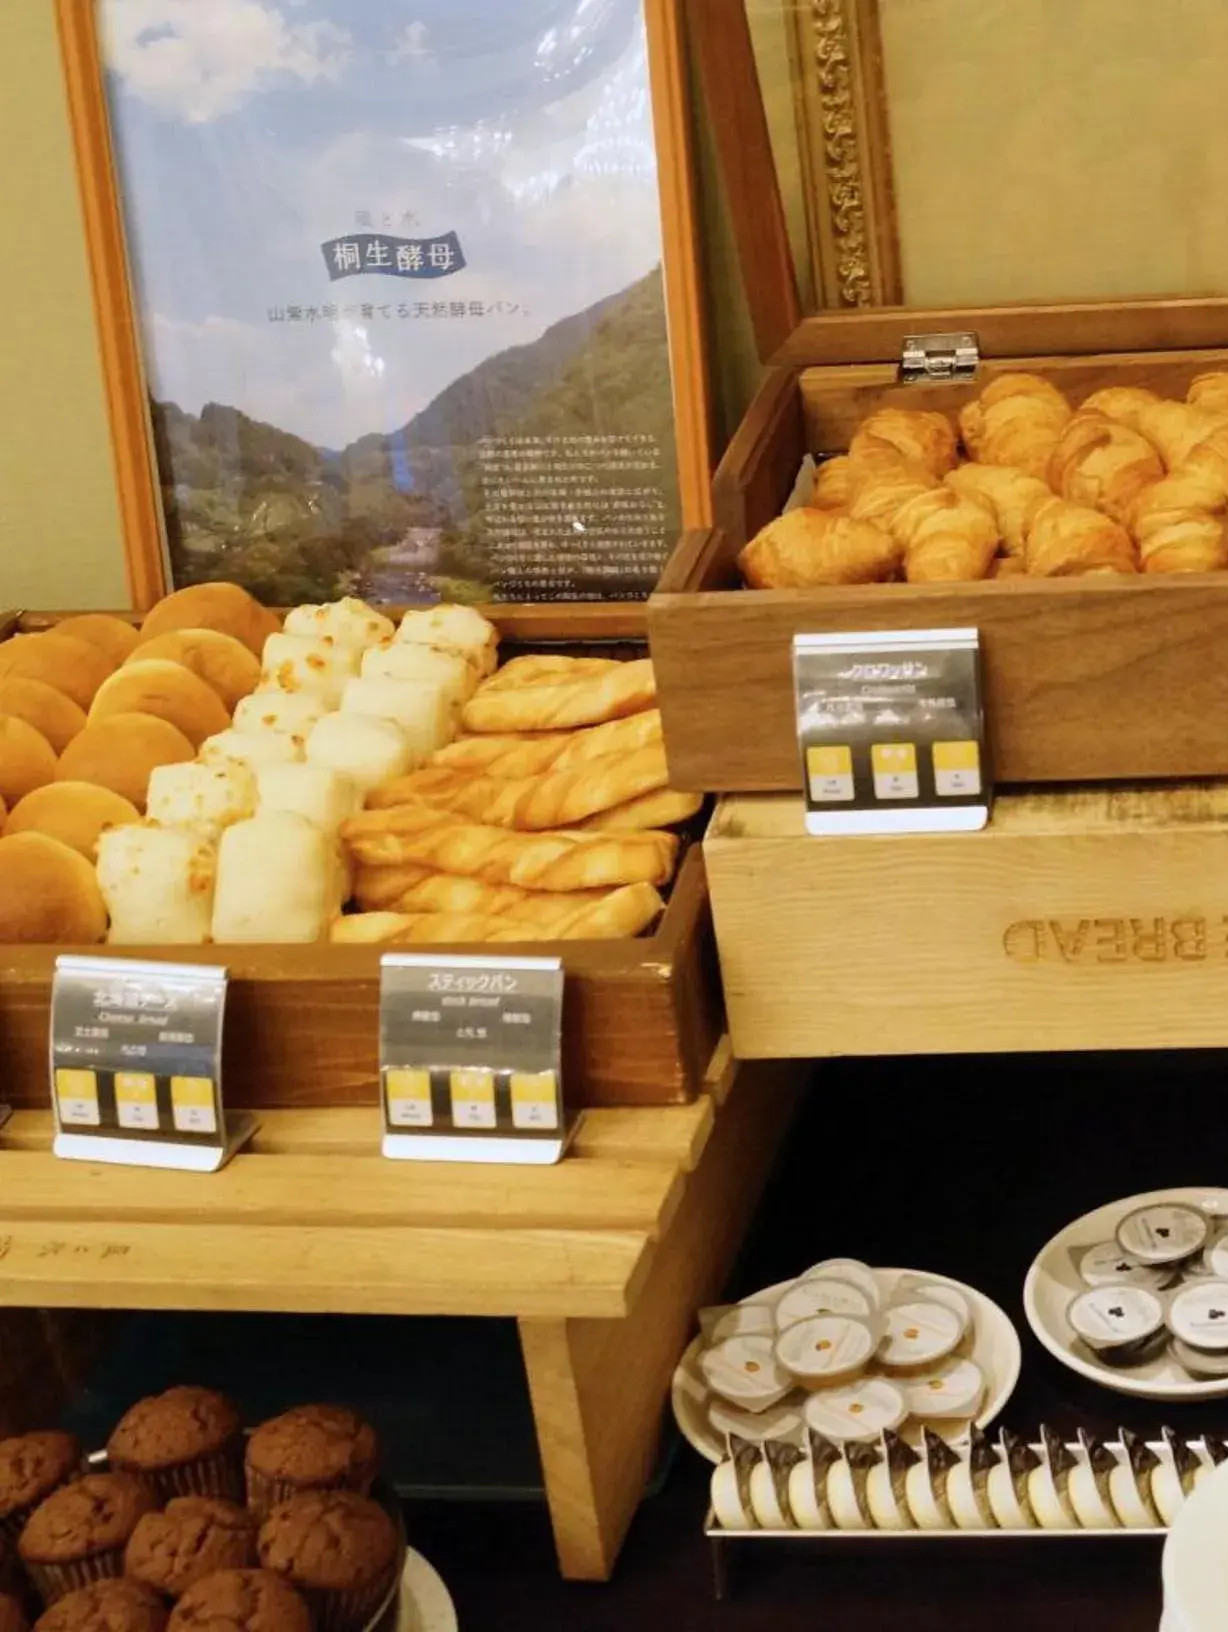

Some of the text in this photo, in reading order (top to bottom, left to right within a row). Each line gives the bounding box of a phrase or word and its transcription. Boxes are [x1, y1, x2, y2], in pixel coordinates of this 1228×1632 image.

[333, 240, 455, 271] 桐生酵母
[1002, 916, 1208, 964] BREAD
[428, 974, 518, 992] スティックパン
